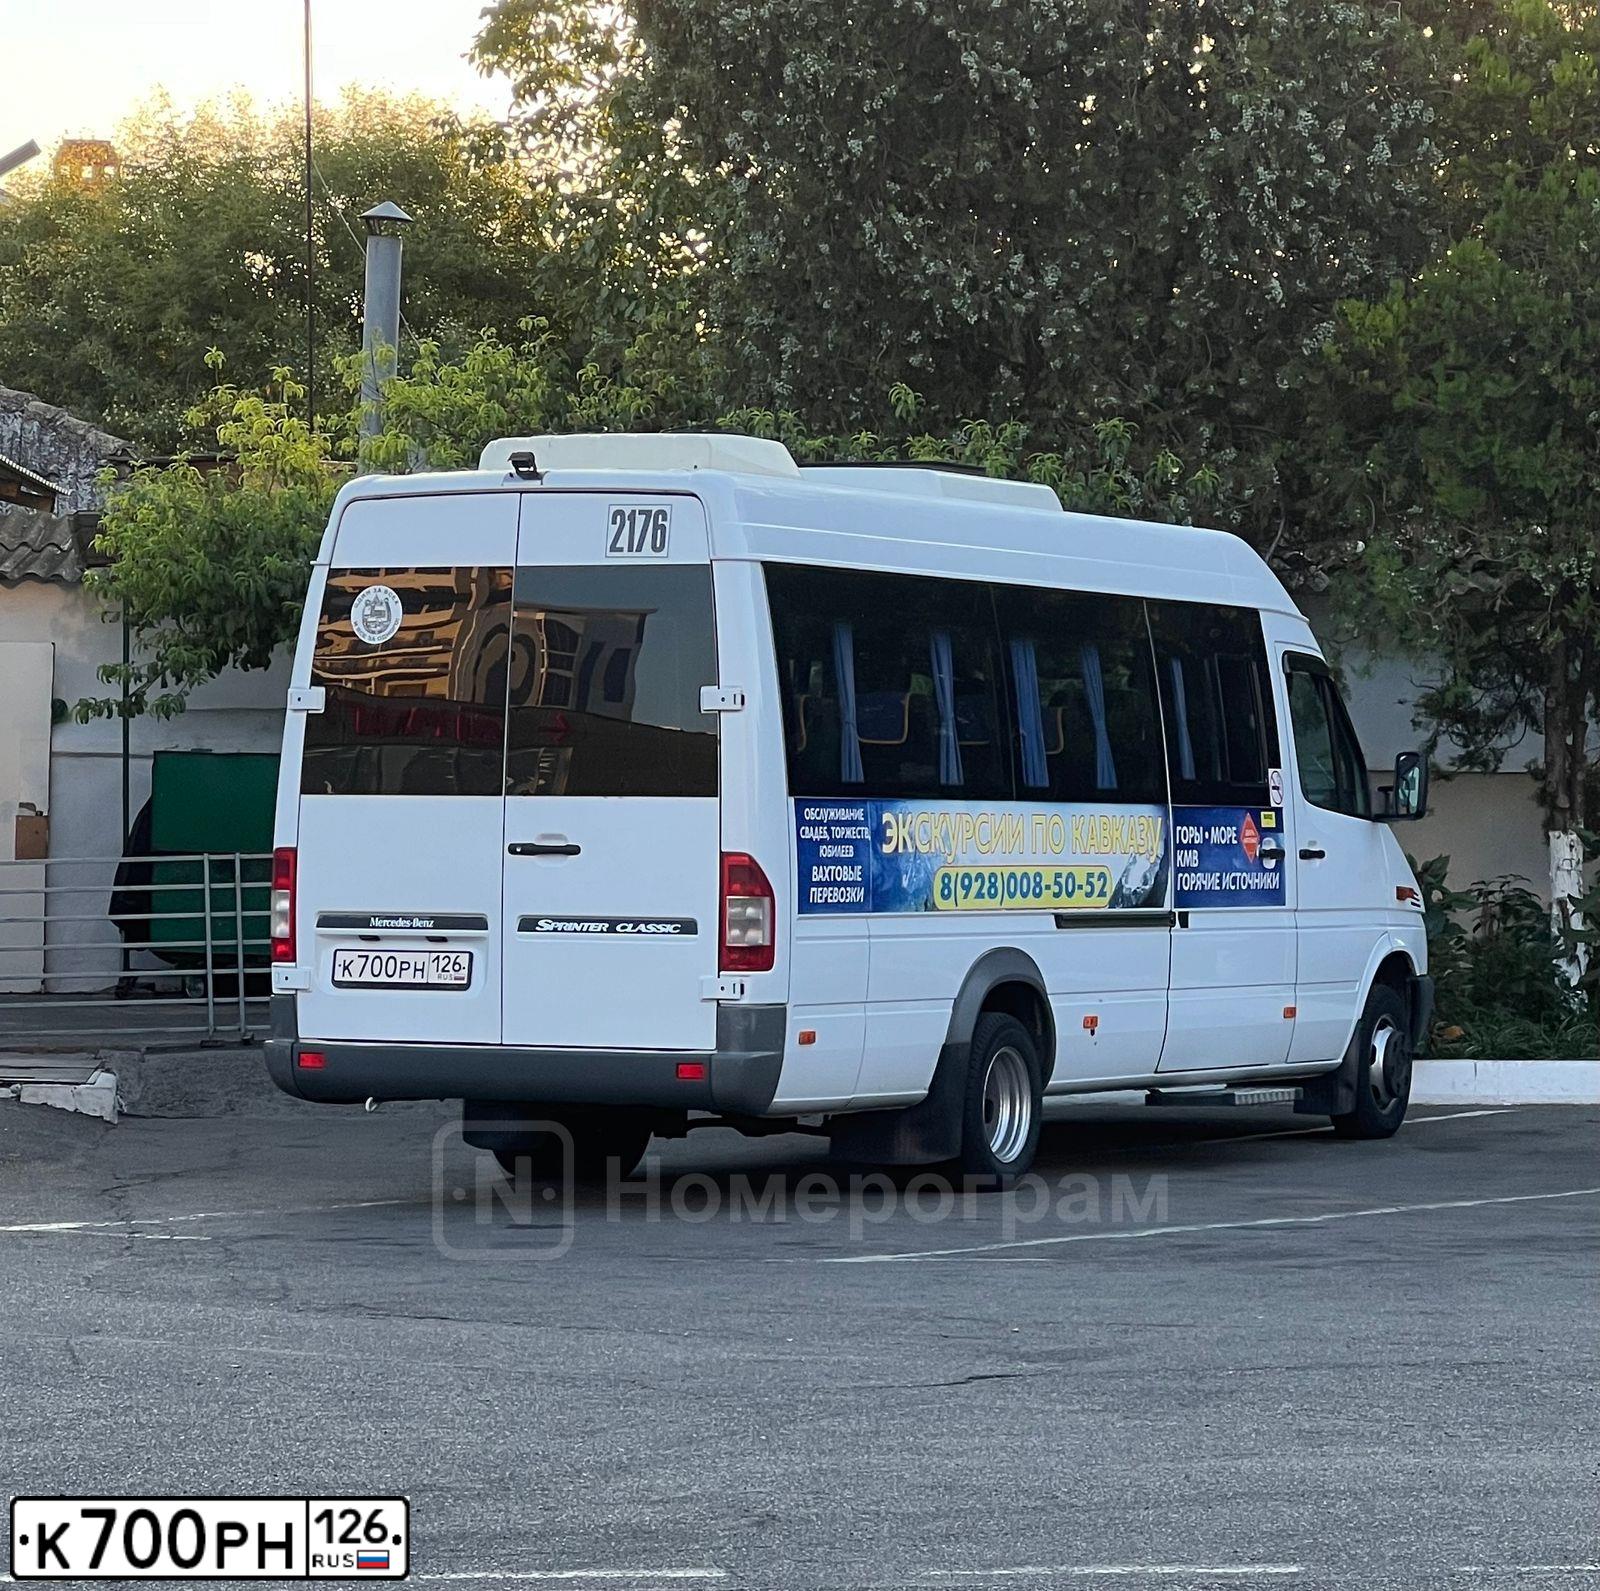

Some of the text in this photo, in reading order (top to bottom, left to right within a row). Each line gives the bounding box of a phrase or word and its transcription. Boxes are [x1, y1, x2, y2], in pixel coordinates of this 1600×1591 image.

[609, 509, 668, 553] 2176
[804, 808, 864, 823] ОБСЛУЖИВАНИЕ
[800, 827, 830, 841] СВАДЕБ,
[881, 812, 1163, 864] ЭКСКУРСИИ ПО КАВКАЗУ
[1176, 826, 1203, 844] ГОРЫ
[1210, 827, 1237, 844] МОРЕ
[819, 845, 854, 857] ЮБИЛЕЕВ
[1176, 850, 1199, 868] КМВ
[812, 865, 862, 882] ВАХТОВЫЕ
[1177, 872, 1280, 891] ГОРЯЧИЕ ИСТОЧНИКИ
[809, 887, 864, 903] ПЕРЕВОЗКИ
[940, 871, 1108, 907] 8(928)008-50-52
[369, 916, 434, 928] Mercedes-Benz
[615, 923, 681, 934] CLASSIC
[341, 955, 461, 979] К700РН 126
[437, 973, 453, 981] RUS
